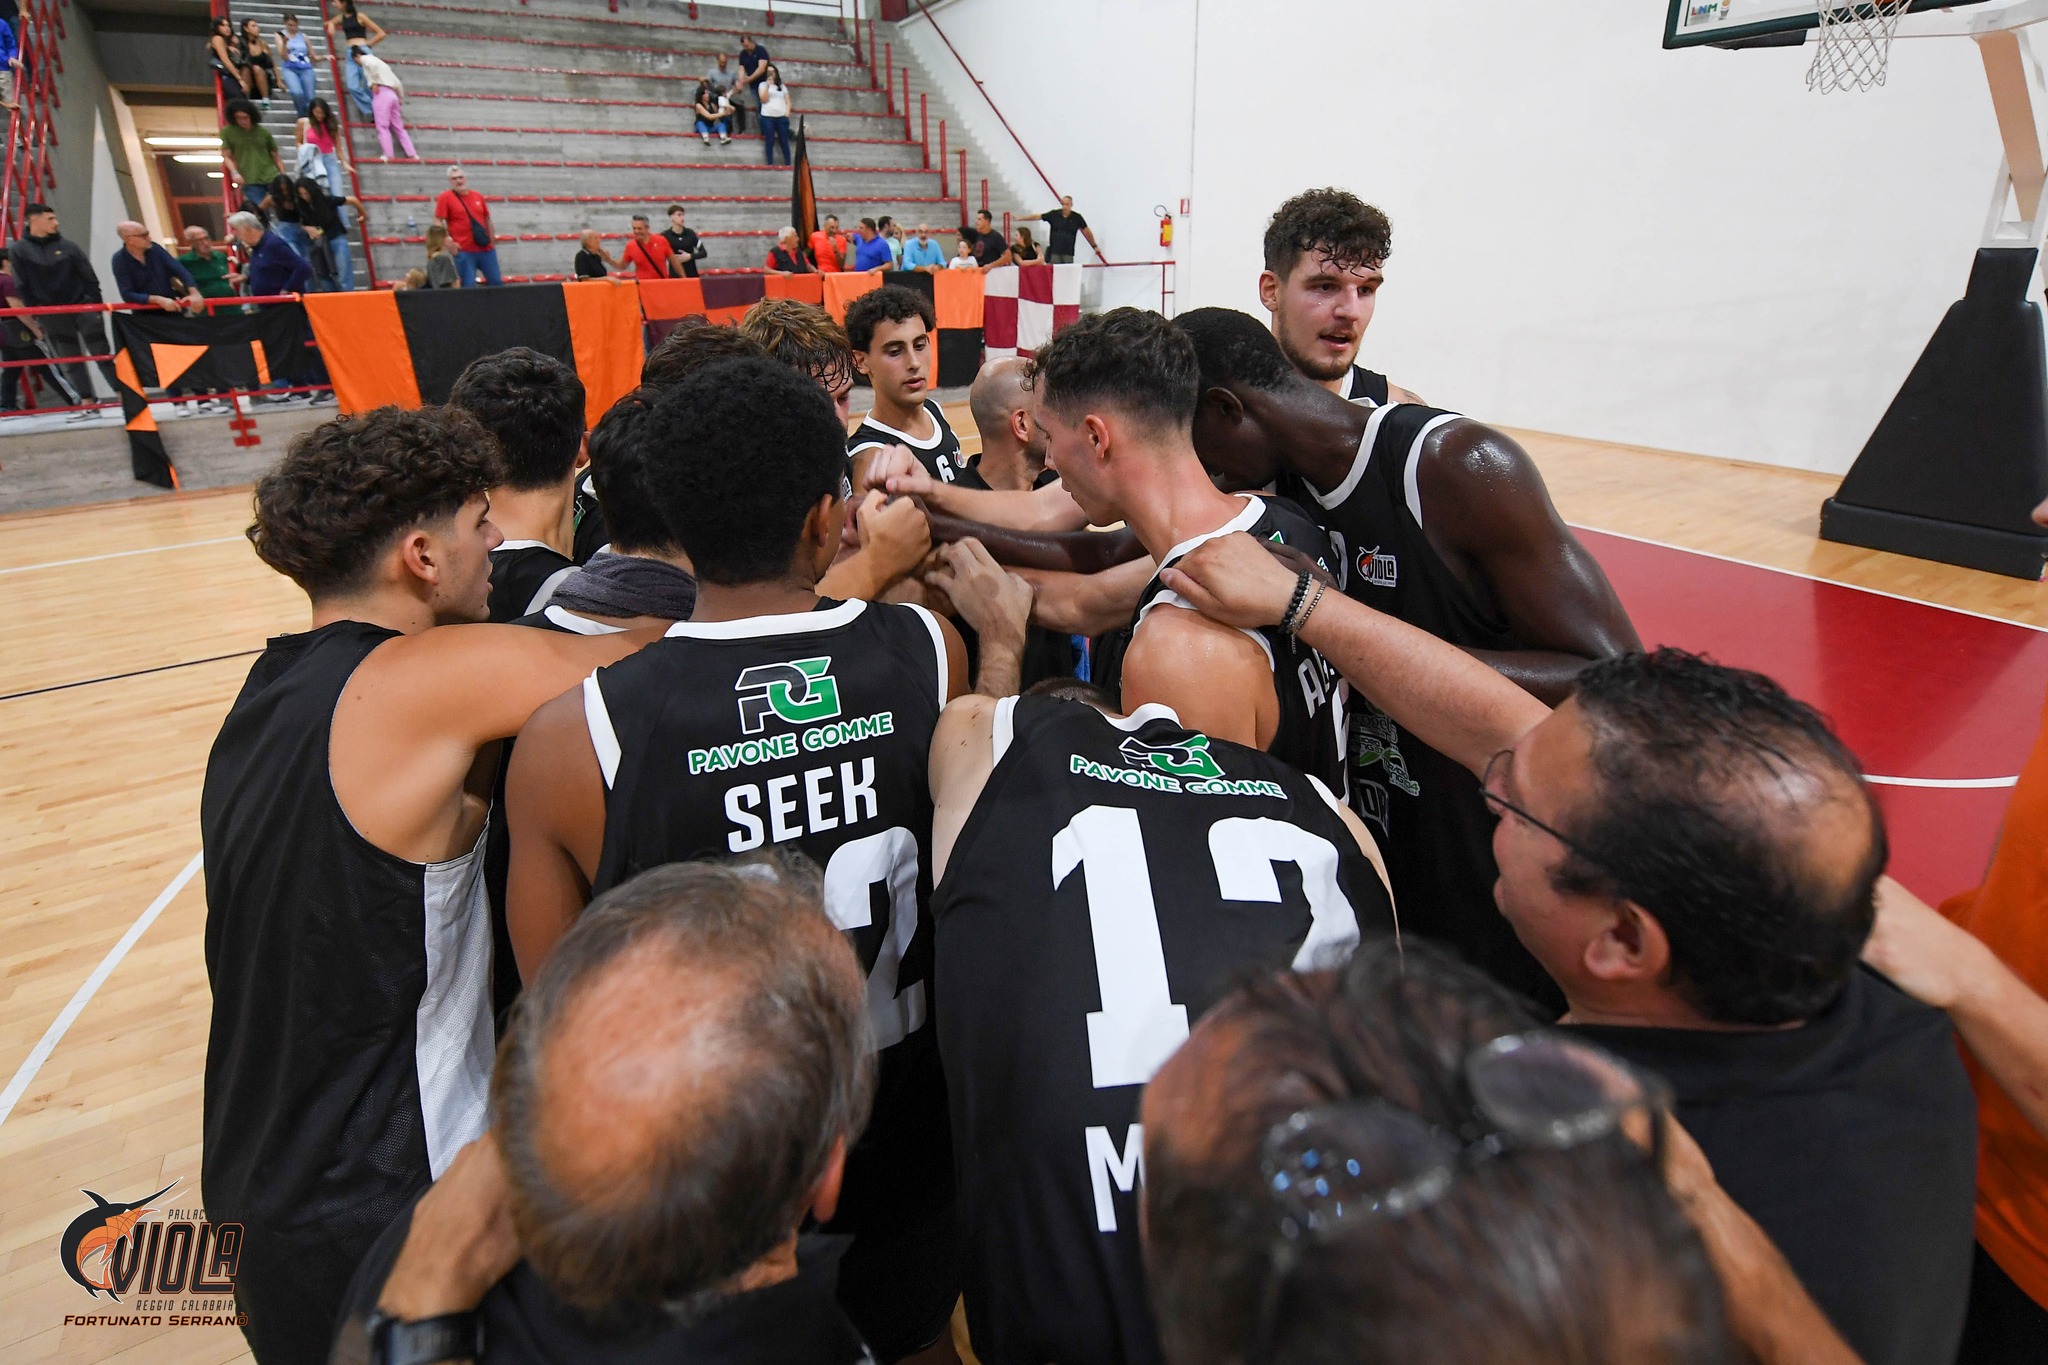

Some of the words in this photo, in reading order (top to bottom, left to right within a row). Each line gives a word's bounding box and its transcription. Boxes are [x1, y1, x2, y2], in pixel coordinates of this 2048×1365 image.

[936, 455, 955, 483] 6
[688, 735, 799, 775] PAVONE
[801, 711, 894, 757] GOMME
[1070, 753, 1183, 793] PAVONE
[1185, 779, 1289, 800] GOMME
[723, 756, 878, 853] SEEK
